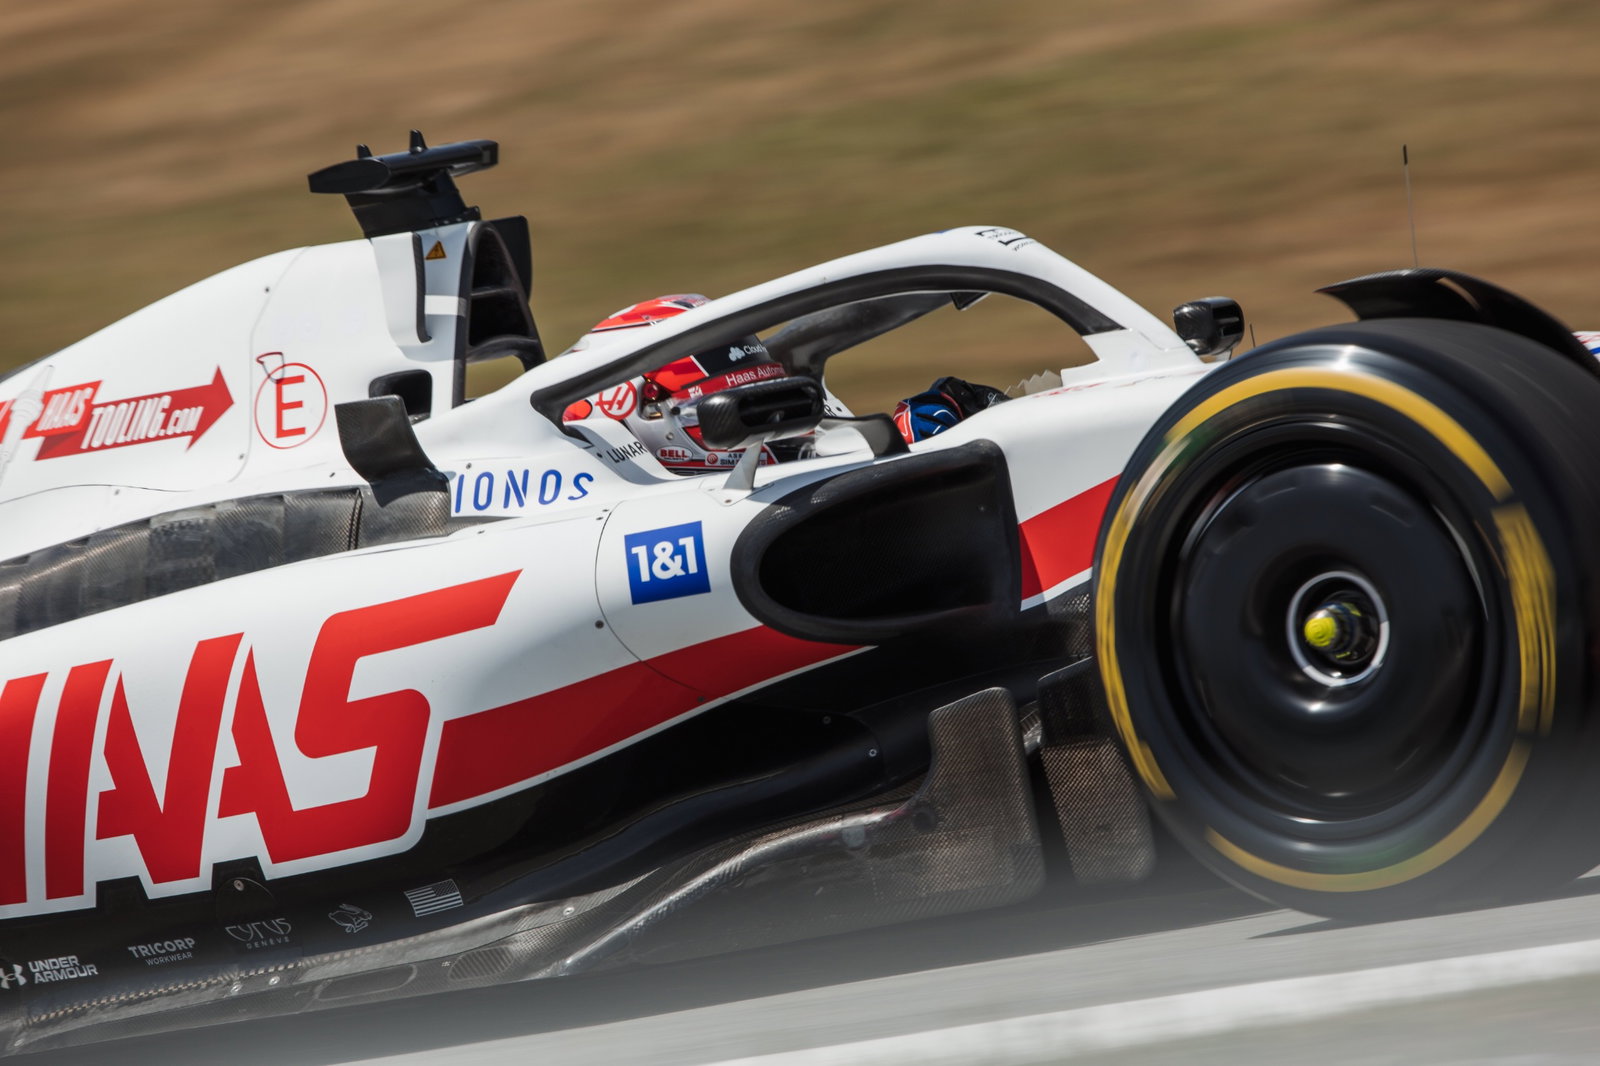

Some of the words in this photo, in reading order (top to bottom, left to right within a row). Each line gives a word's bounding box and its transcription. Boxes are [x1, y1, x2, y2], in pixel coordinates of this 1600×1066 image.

[725, 371, 757, 387] Haas
[606, 441, 648, 463] LUNAR
[660, 448, 689, 458] BELL
[454, 469, 594, 513] IONOS
[631, 535, 699, 583] 1&1
[127, 937, 196, 959] TRICORP
[145, 951, 193, 966] WORKWEAR
[28, 955, 80, 973] UNDER
[34, 964, 99, 985] ARMOUR
